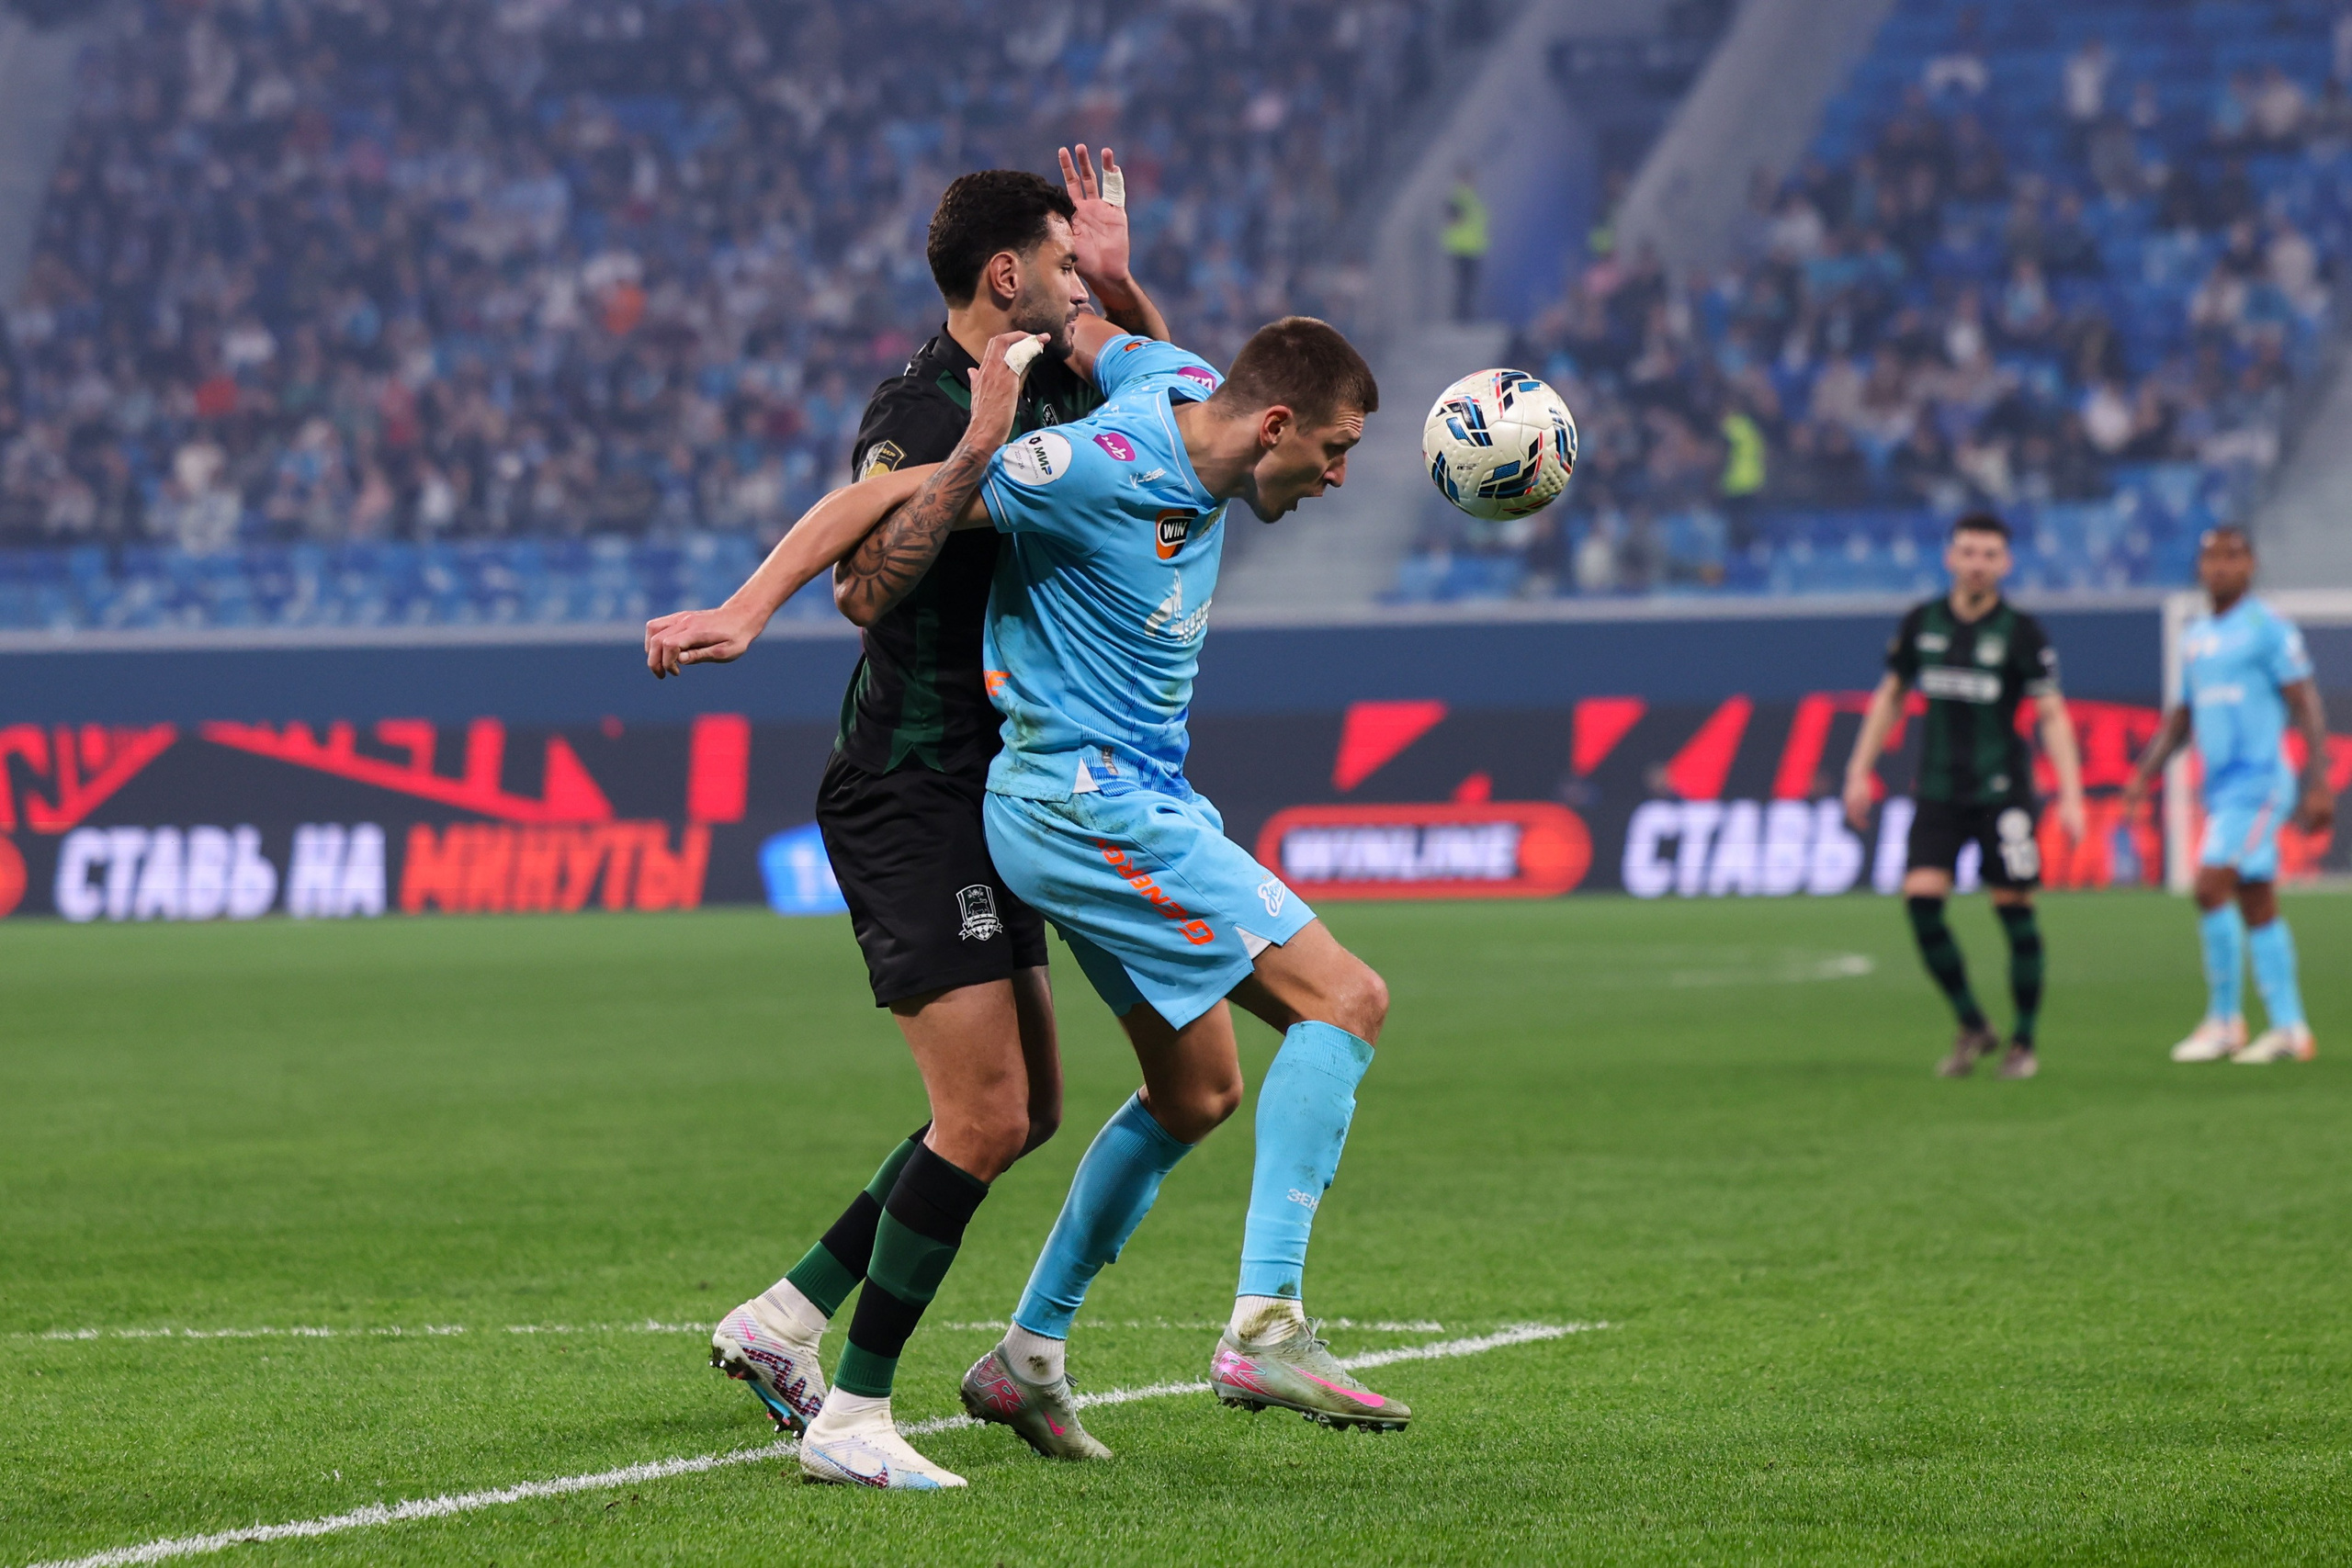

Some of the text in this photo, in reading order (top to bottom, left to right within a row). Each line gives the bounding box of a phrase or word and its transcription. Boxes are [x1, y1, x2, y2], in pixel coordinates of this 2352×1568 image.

[1034, 446, 1053, 476] МИР
[1163, 521, 1188, 540] WIN
[54, 825, 278, 921] СТАВЬ
[284, 822, 388, 919] НА
[399, 821, 713, 913] МИНУТЫ
[1282, 821, 1521, 882] WINLINE
[1621, 798, 1865, 899] СТАВЬ
